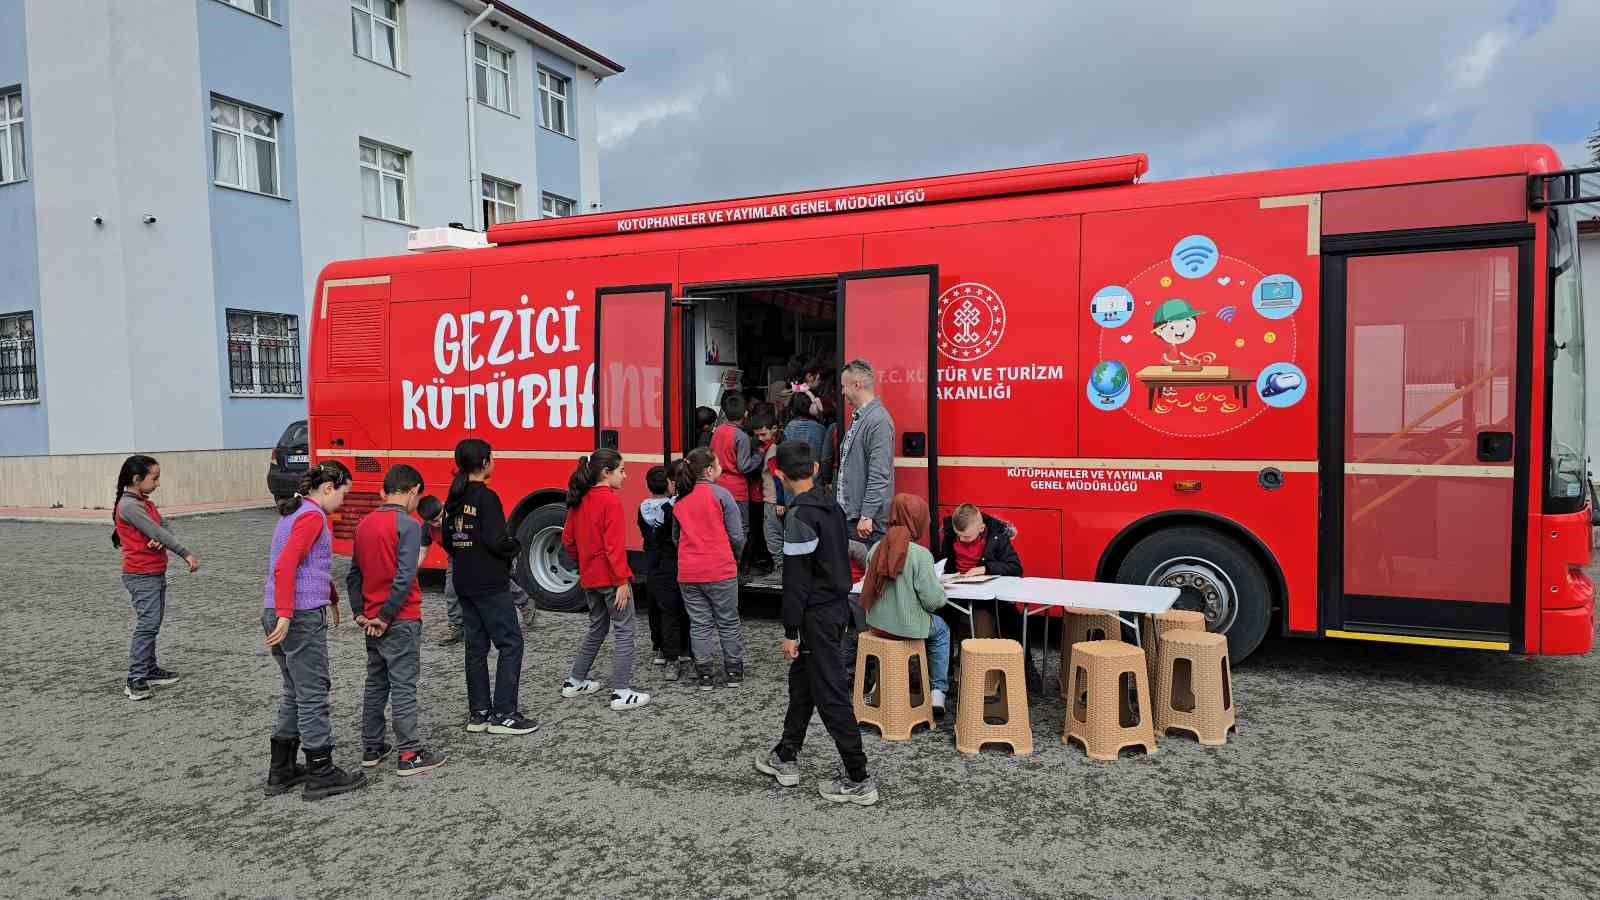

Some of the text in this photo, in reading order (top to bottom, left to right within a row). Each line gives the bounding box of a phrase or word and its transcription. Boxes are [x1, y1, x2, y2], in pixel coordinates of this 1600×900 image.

[709, 211, 723, 223] VE
[726, 204, 787, 221] YAYIMLAR
[791, 200, 832, 216] GENEL
[835, 188, 925, 210] MÜDÜRLÜĞÜ
[433, 289, 581, 375] GEZİCİ
[972, 367, 992, 381] VE
[996, 363, 1064, 380] TURİZM
[936, 382, 1011, 400] AKANLIĞI
[1007, 466, 1163, 481] KÜTÜPHANELER VE YAYIMLAR
[1030, 479, 1138, 492] GENEL MÜDÜRLÜĞÜ
